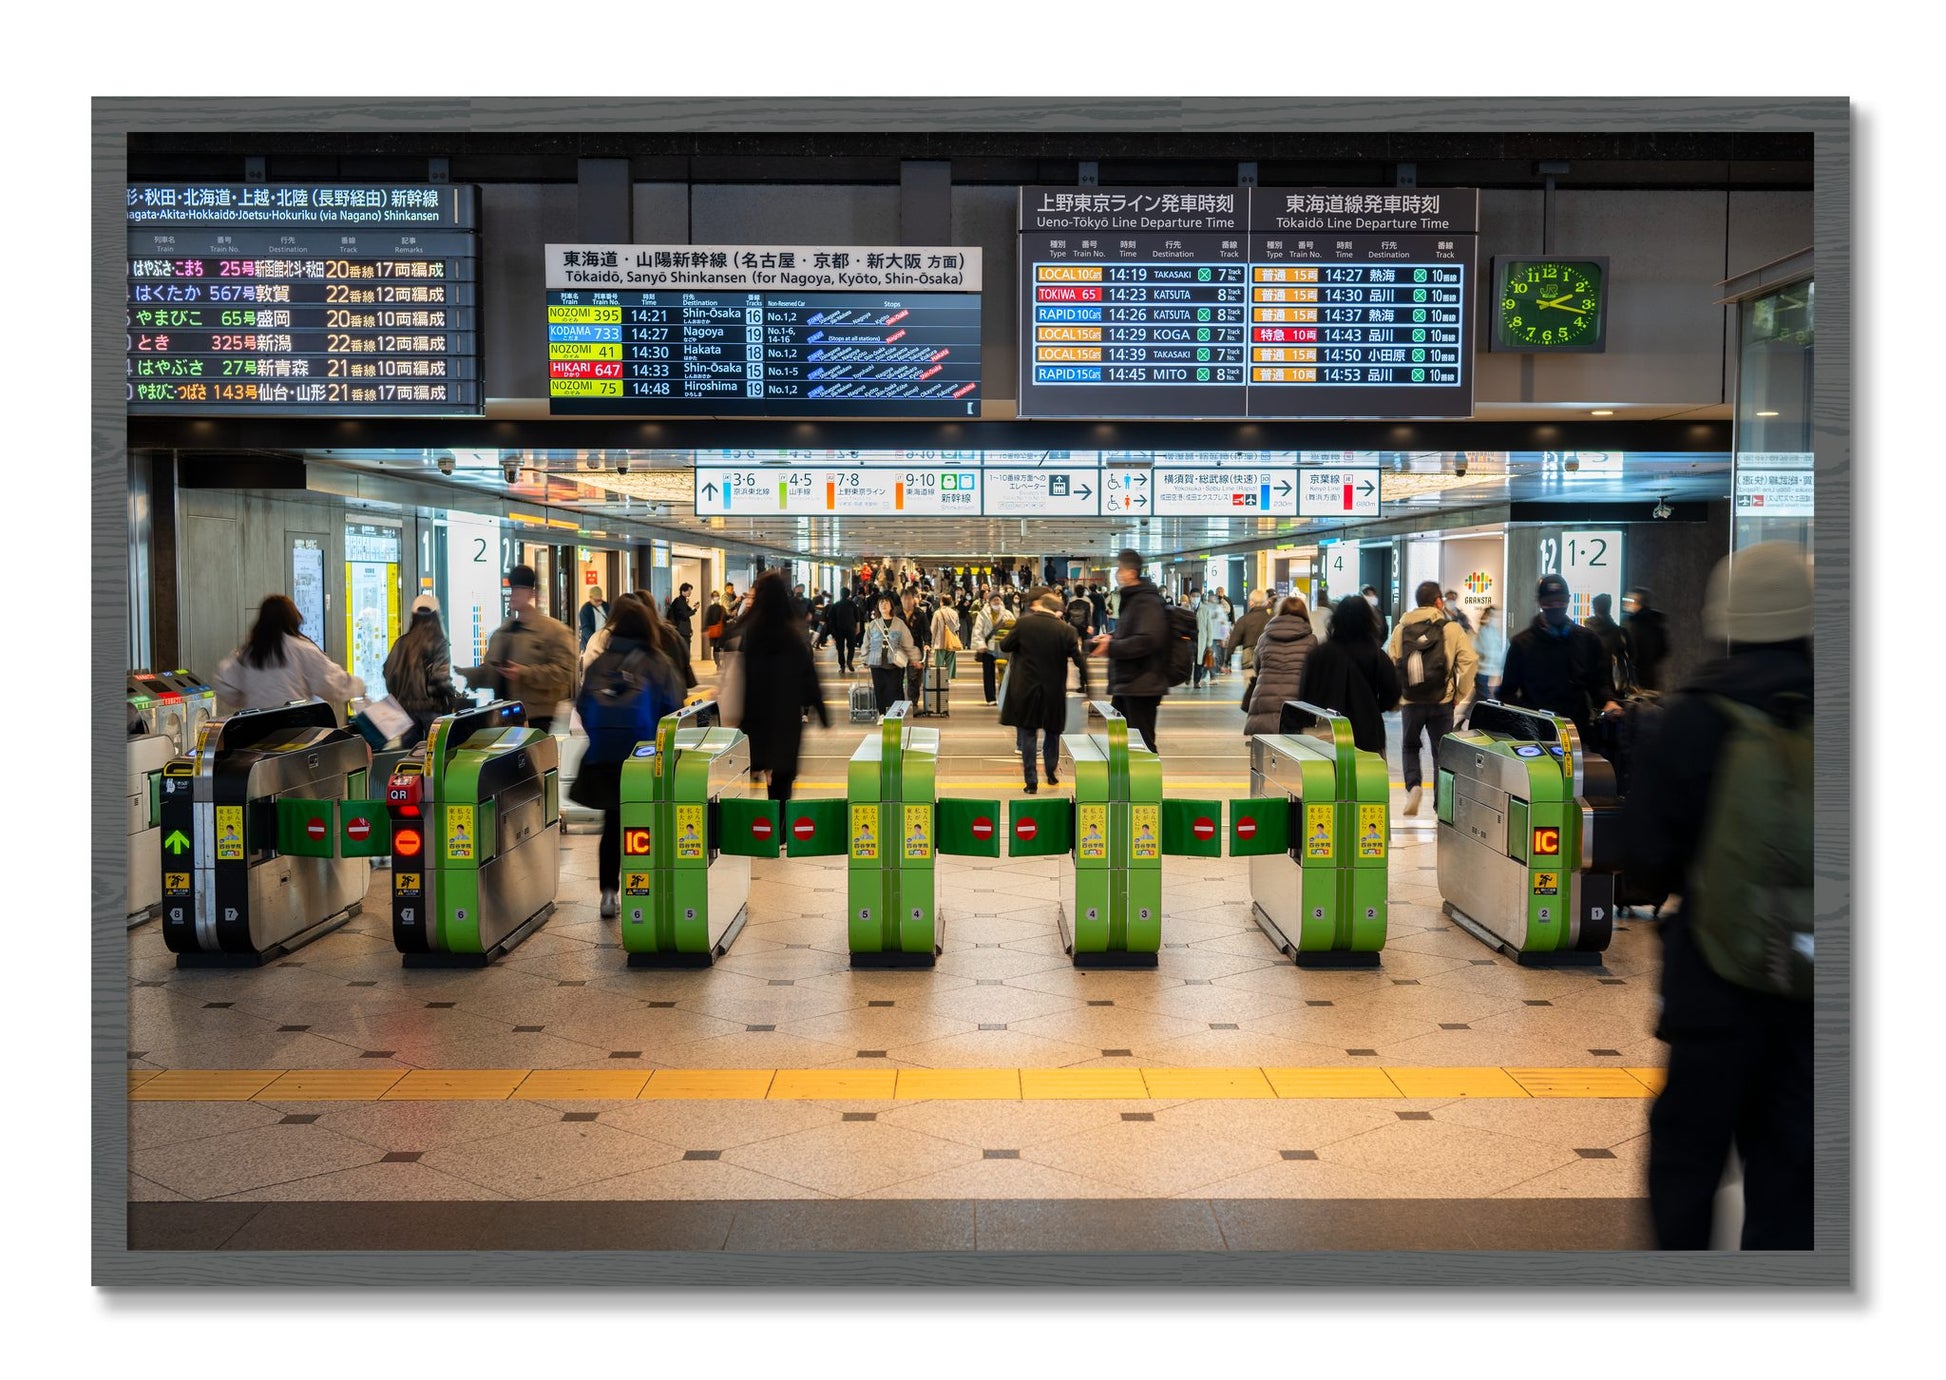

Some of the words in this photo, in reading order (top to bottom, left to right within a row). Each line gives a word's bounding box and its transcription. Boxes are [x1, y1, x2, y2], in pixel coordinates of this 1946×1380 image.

[1037, 194, 1234, 213] 上野東京ライン発車時刻
[1286, 194, 1440, 214] 東海道線発車時刻
[320, 210, 338, 222] (via
[340, 210, 381, 222] Nagano)
[384, 210, 439, 221] Shinkansen
[1037, 217, 1109, 229] Ueno-Tōkyō
[1112, 217, 1137, 228] Line
[1141, 217, 1202, 230] Departure
[1205, 217, 1235, 228] Time
[1276, 217, 1324, 229] Tōkaidō
[1327, 217, 1352, 229] Line
[1356, 217, 1417, 231] Departure
[1420, 218, 1449, 229] Time
[1049, 250, 1067, 258] Type
[220, 261, 255, 277] 25号
[1039, 269, 1076, 280] LOCAL
[1109, 268, 1146, 281] 14:19
[1154, 270, 1191, 279] TAKASAKI
[1325, 269, 1362, 282] 14:27
[1370, 269, 1395, 282] 熱海
[1543, 268, 1557, 278] 12
[566, 271, 624, 285] Tōkaidō,
[627, 271, 667, 285] Sanyō
[671, 271, 747, 283] Shinkansen
[751, 271, 777, 285] (for
[780, 271, 835, 286] Nagoya,
[838, 271, 881, 286] Kyōto,
[885, 271, 963, 287] Shin-Ōsaka)
[1528, 273, 1540, 282] 11
[1564, 272, 1569, 281] 1
[1514, 284, 1528, 293] 10
[1576, 282, 1584, 292] 2
[136, 286, 200, 302] はくたか
[210, 286, 255, 302] 567号
[255, 285, 290, 303] 敦賀
[1040, 289, 1075, 300] TOKIWA
[1109, 288, 1146, 301] 14:23
[1154, 290, 1191, 300] KATSUTA
[1325, 289, 1362, 302] 14:30
[1370, 289, 1394, 302] 品川
[1506, 299, 1515, 309] 9
[1582, 300, 1591, 309] 3
[137, 311, 202, 326] やまびこ
[222, 311, 255, 326] 65号
[257, 311, 291, 327] 盛岡
[549, 307, 591, 318] NOZOMI
[594, 309, 619, 321] 395
[631, 309, 667, 322] 14:21
[683, 307, 741, 319] Shin-Ōsaka
[747, 310, 762, 323] 16
[1039, 309, 1076, 320] RAPID
[1109, 308, 1146, 321] 14:26
[1154, 310, 1191, 320] KATSUTA
[1325, 309, 1362, 322] 14:37
[1369, 309, 1394, 322] 熱海
[1513, 317, 1522, 326] 8
[1574, 317, 1583, 326] 4
[550, 326, 591, 336] KODAMA
[594, 328, 620, 340] 733
[631, 328, 668, 340] 14:27
[683, 326, 724, 339] Nagoya
[747, 329, 762, 341] 19
[1039, 329, 1076, 340] LOCAL
[1109, 328, 1146, 341] 14:29
[1154, 330, 1191, 340] KOGA
[1325, 328, 1362, 341] 14:43
[1368, 328, 1394, 342] 品川
[1527, 327, 1536, 337] 7
[1543, 331, 1551, 340] 6
[1559, 328, 1567, 337] 5
[138, 335, 169, 351] とき
[212, 335, 256, 351] 325号
[257, 335, 291, 352] 新潟
[550, 344, 591, 354] NOZOMI
[599, 346, 616, 359] 41
[632, 346, 669, 359] 14:30
[684, 345, 721, 355] Hakata
[747, 346, 762, 359] 18
[1039, 349, 1075, 360] LOCAL
[1109, 348, 1146, 361] 14:39
[1154, 350, 1191, 359] TAKASAKI
[1325, 348, 1361, 361] 14:50
[1368, 348, 1405, 362] 小田原
[138, 360, 203, 376] はやぶさ
[223, 360, 256, 376] 27号
[257, 360, 309, 376] 新青森
[552, 363, 591, 373] HIKARI
[595, 364, 621, 377] 647
[632, 364, 669, 377] 14:33
[684, 362, 742, 374] Shin-Ōsaka
[747, 365, 762, 377] 15
[1039, 368, 1076, 380] RAPID
[1109, 368, 1146, 381] 14:45
[1154, 369, 1186, 380] MITO
[1324, 368, 1361, 381] 14:53
[1368, 368, 1392, 381] 品川
[214, 385, 257, 400] 143号
[551, 381, 592, 391] NOZOMI
[600, 383, 617, 395] 75
[633, 383, 670, 395] 14:48
[684, 381, 737, 391] Hiroshima
[747, 383, 763, 396] 19
[1309, 474, 1340, 484] 京葉線
[941, 494, 971, 503] 新幹線
[422, 532, 430, 572] 1
[473, 539, 487, 562] 2
[1568, 539, 1607, 566] 1·2
[1334, 556, 1343, 570] 4
[1393, 549, 1399, 578] 3
[1465, 596, 1491, 604] GRANSTA
[391, 790, 406, 799] QR
[627, 831, 648, 852] IC
[1535, 832, 1557, 851] IC
[228, 910, 234, 918] 7
[406, 910, 411, 918] 7
[458, 911, 463, 919] 6
[635, 911, 640, 919] 6
[687, 909, 693, 918] 5
[862, 910, 868, 918] 5
[914, 910, 919, 918] 4
[1090, 910, 1095, 918] 4
[1142, 910, 1147, 918] 3
[1368, 909, 1374, 917] 2
